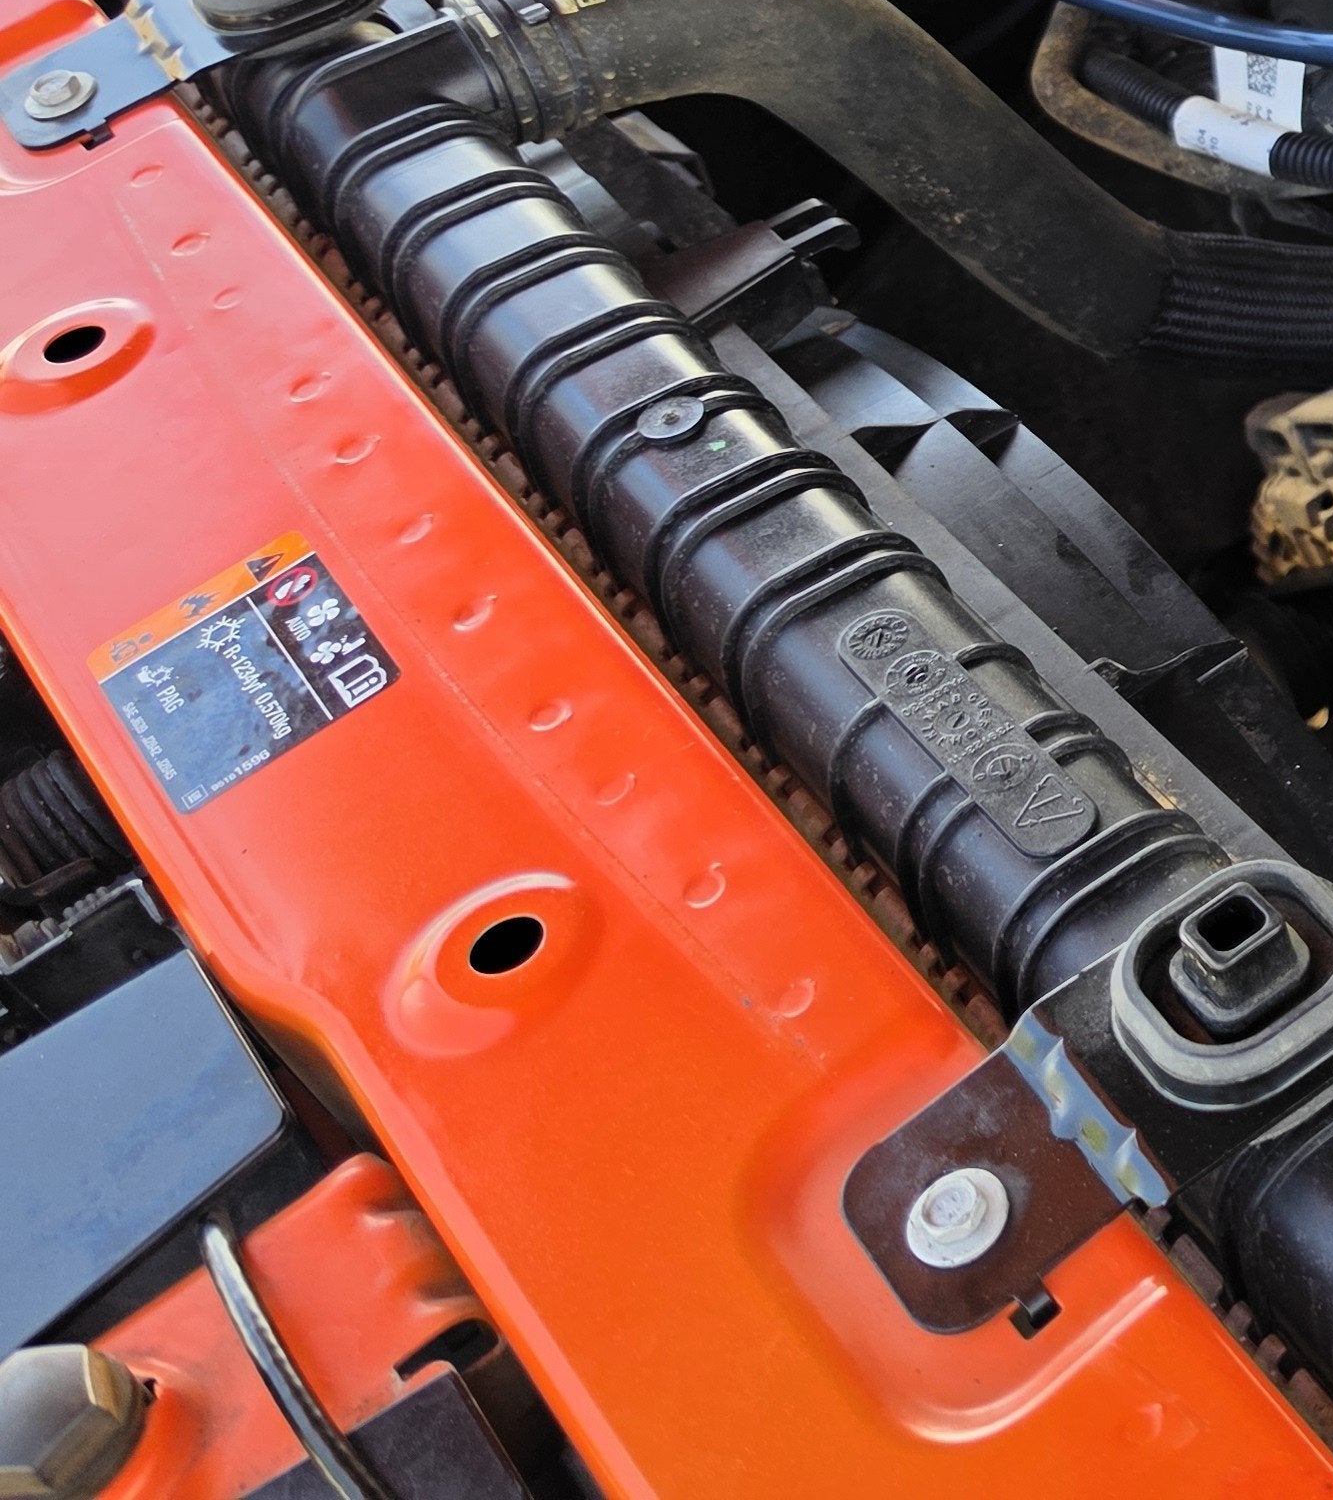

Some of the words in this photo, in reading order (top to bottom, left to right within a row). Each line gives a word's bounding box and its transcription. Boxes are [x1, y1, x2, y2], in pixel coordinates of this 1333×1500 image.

[284, 615, 312, 642] AUTO
[155, 684, 186, 715] PAG
[221, 644, 266, 694] R-1234yf
[253, 691, 293, 741] 0.570kg
